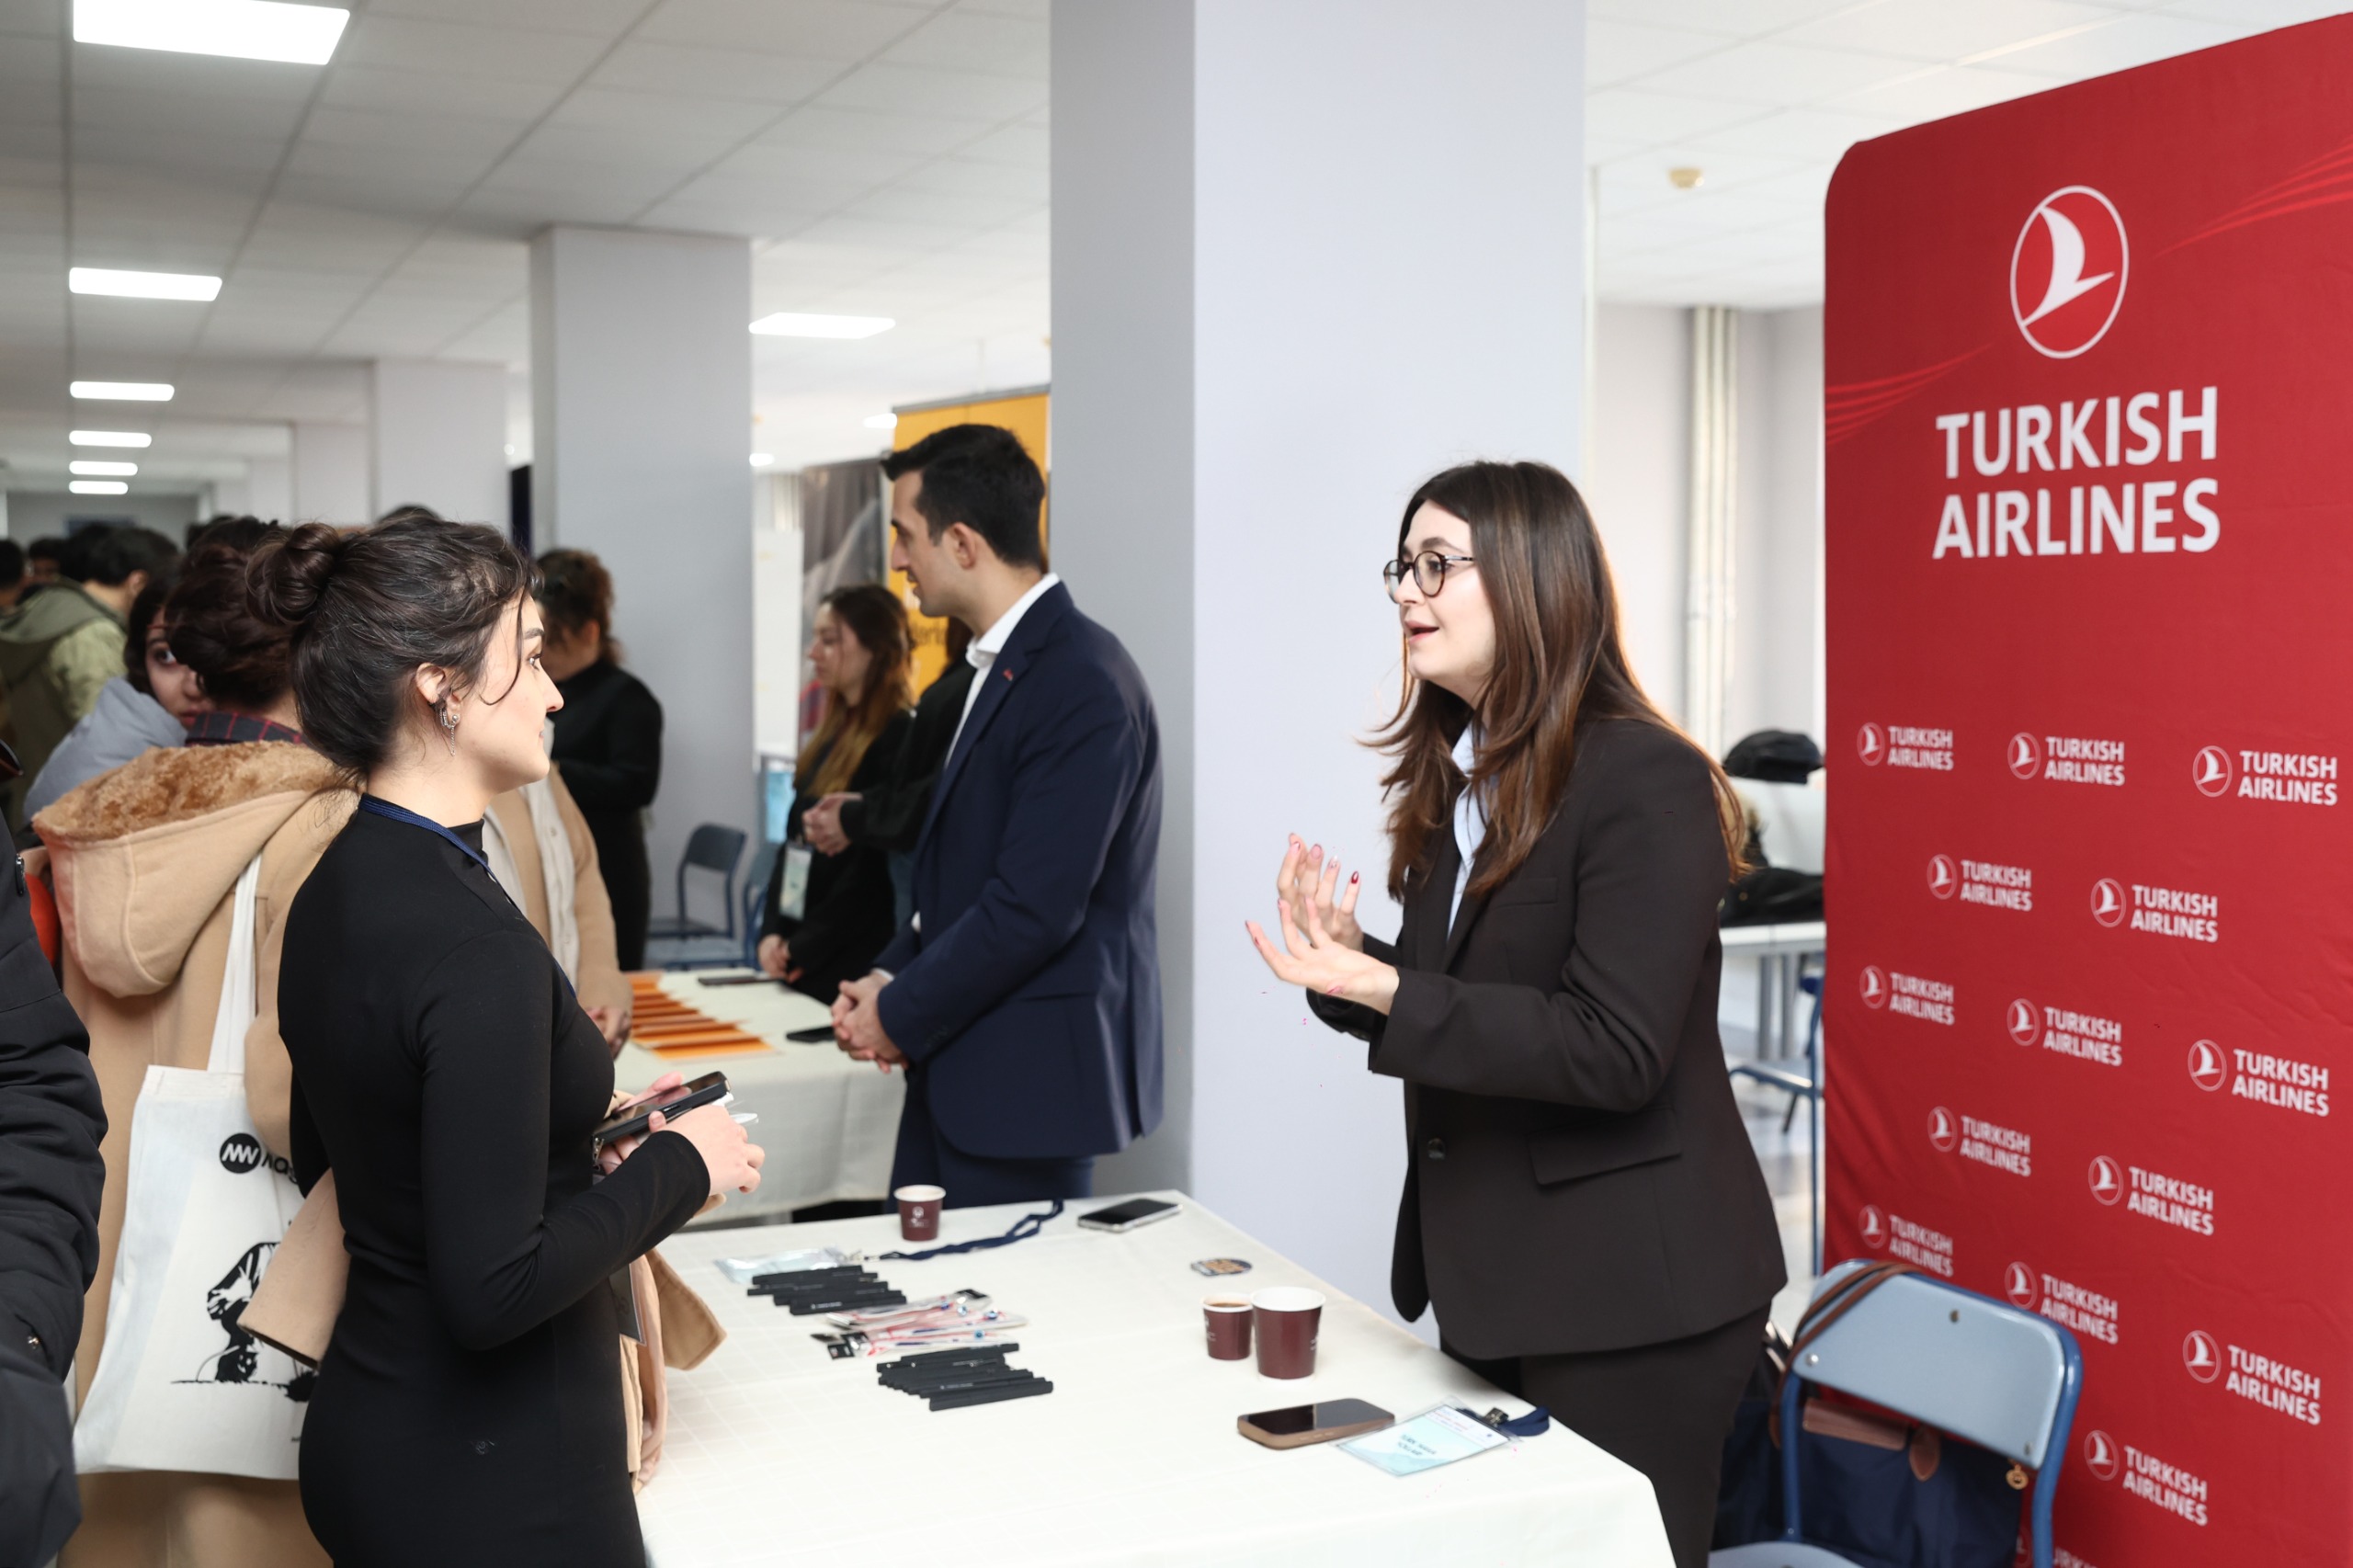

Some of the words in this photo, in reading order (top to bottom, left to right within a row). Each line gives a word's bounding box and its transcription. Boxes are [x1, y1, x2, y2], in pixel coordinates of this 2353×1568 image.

[1936, 385, 2218, 479] TURKISH
[1932, 477, 2221, 560] AIRLINES
[1888, 725, 1953, 749] TURKISH
[2045, 736, 2125, 763] TURKISH
[1887, 747, 1954, 771] AIRLINES
[2044, 759, 2126, 787] AIRLINES
[2239, 750, 2338, 780] TURKISH
[2237, 775, 2338, 806] AIRLINES
[1961, 859, 2031, 889] TURKISH
[1960, 881, 2032, 912] AIRLINES
[2131, 884, 2218, 918] TURKISH
[2130, 908, 2219, 943] AIRLINES
[1891, 972, 1954, 1003] TURKISH
[1889, 994, 1955, 1026] AIRLINES
[2043, 1006, 2122, 1043] TURKISH
[2043, 1029, 2122, 1067] AIRLINES
[2233, 1048, 2329, 1091] TURKISH
[2232, 1074, 2330, 1118] AIRLINES
[1961, 1116, 2030, 1153] TURKISH
[1960, 1138, 2031, 1176] AIRLINES
[2129, 1166, 2213, 1211] TURKISH
[2127, 1190, 2214, 1236] AIRLINES
[1890, 1214, 1952, 1256] TURKISH
[2042, 1274, 2118, 1321] TURKISH
[2040, 1298, 2119, 1345] AIRLINES
[2227, 1345, 2321, 1401] TURKISH
[2225, 1370, 2321, 1426] AIRLINES
[2125, 1446, 2208, 1502] TURKISH
[2123, 1471, 2208, 1526] AIRLINES
